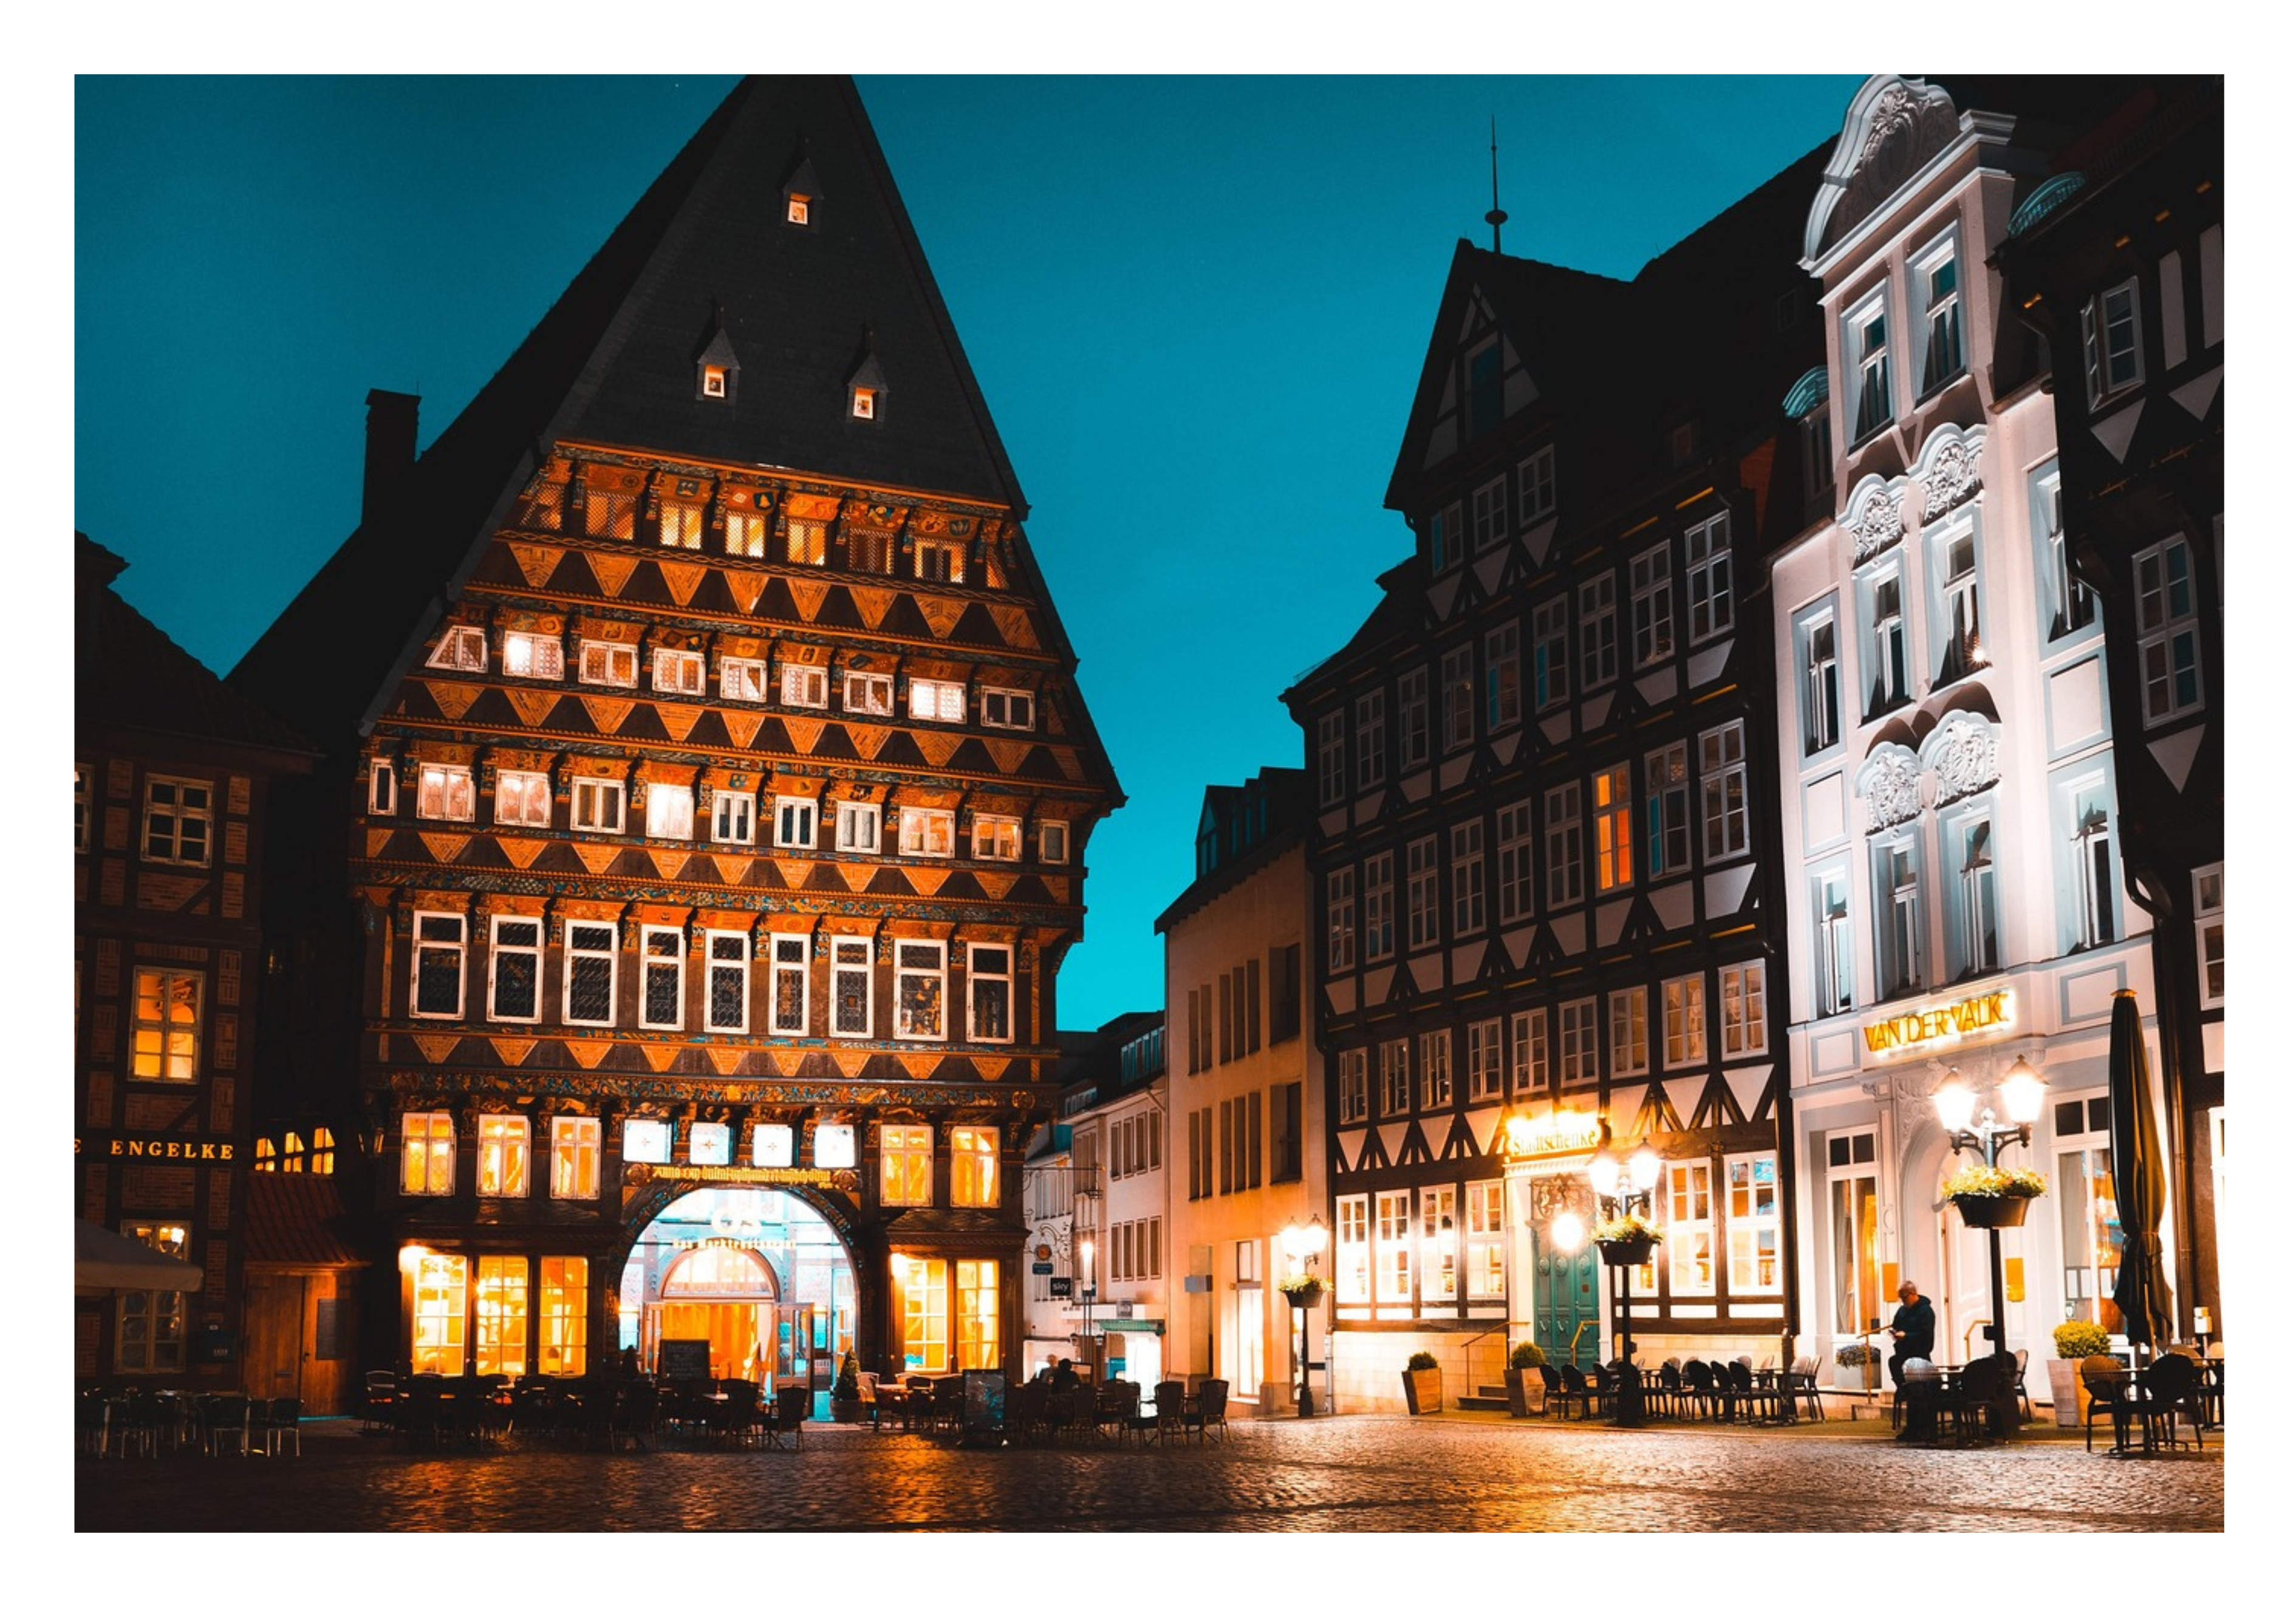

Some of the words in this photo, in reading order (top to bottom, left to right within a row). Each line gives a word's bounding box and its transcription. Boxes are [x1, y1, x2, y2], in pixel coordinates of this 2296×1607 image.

[1864, 1017, 1908, 1052] VAN
[1907, 1010, 1952, 1043] DER
[1950, 992, 2009, 1032] VALK
[111, 1140, 234, 1159] ENGELKE
[1053, 1281, 1069, 1292] sky
